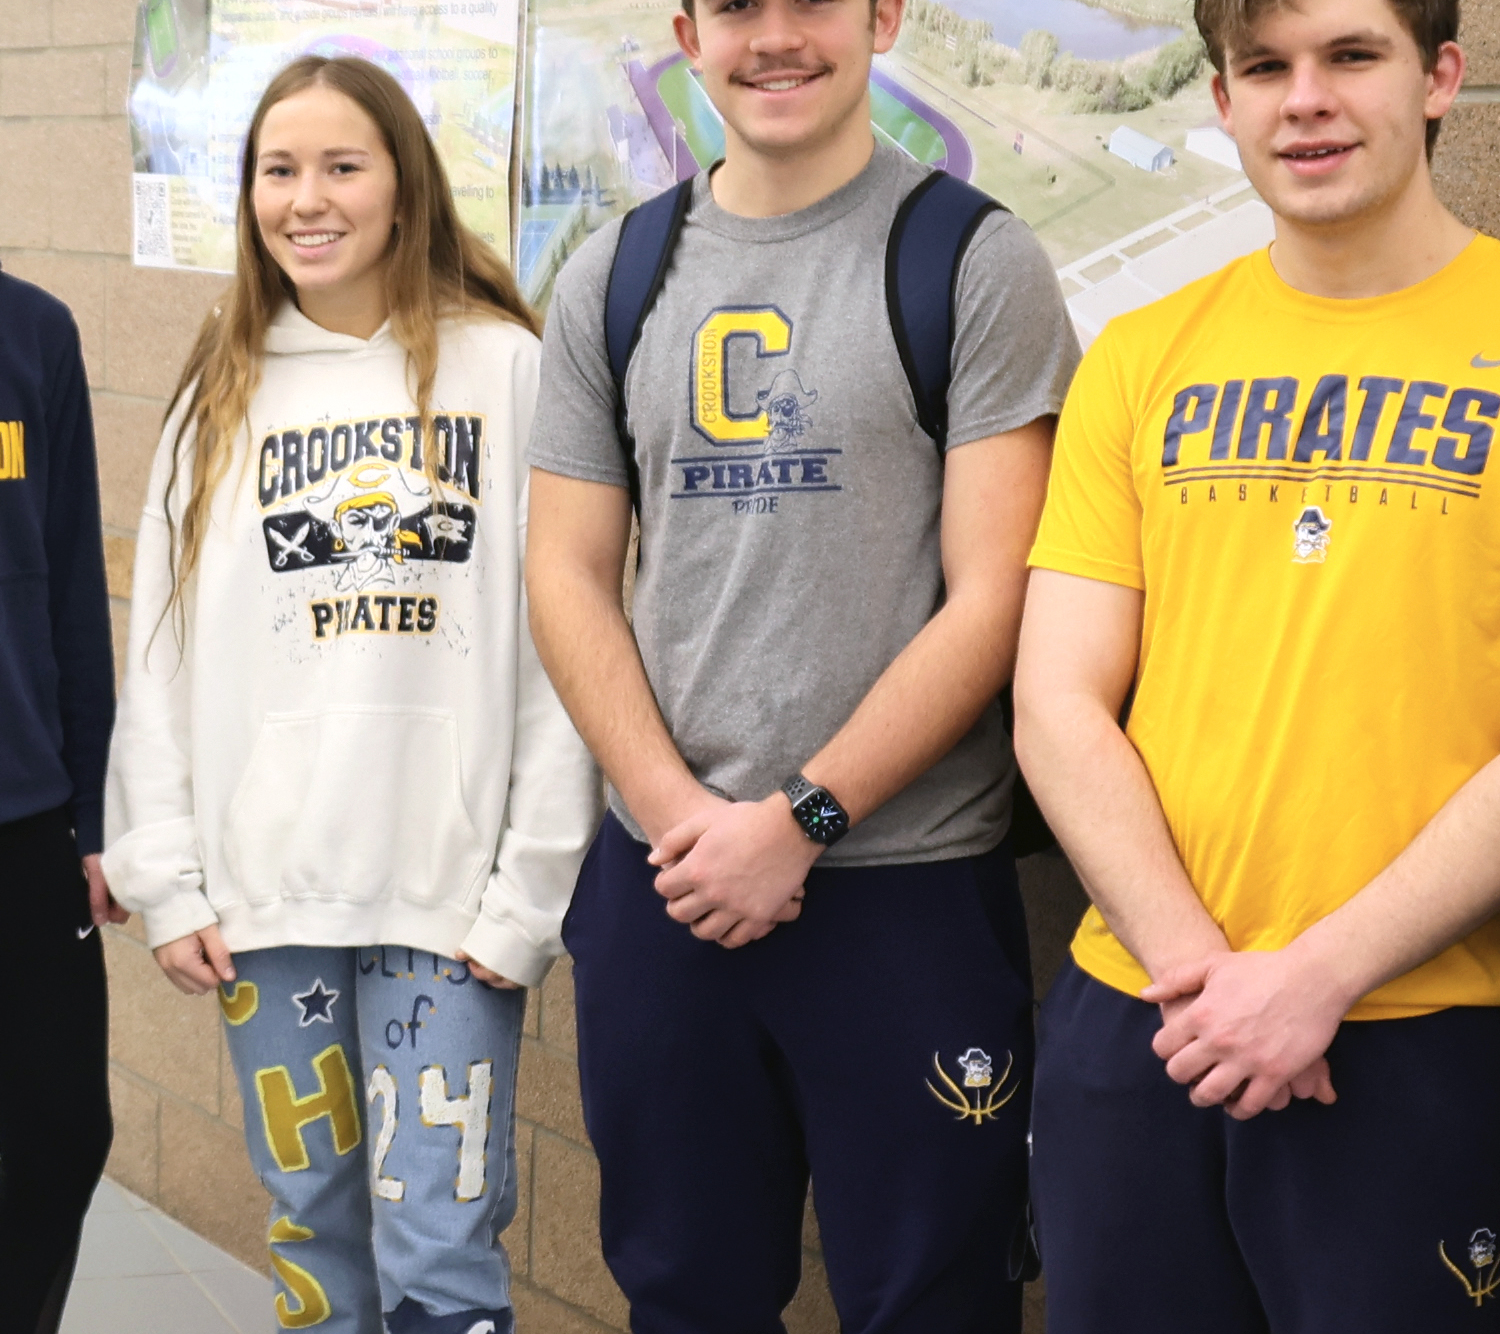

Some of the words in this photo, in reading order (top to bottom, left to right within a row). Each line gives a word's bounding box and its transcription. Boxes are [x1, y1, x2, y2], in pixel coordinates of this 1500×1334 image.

[450, 0, 460, 14] to
[428, 47, 454, 61] school
[455, 46, 486, 64] groups
[487, 46, 498, 60] to
[484, 184, 495, 199] to
[701, 327, 719, 425] CROOKSTON
[256, 413, 485, 510] CROOKSTON
[682, 456, 829, 492] PIRATE
[1180, 483, 1450, 517] BASKETBALL
[365, 1059, 494, 1203] 24
